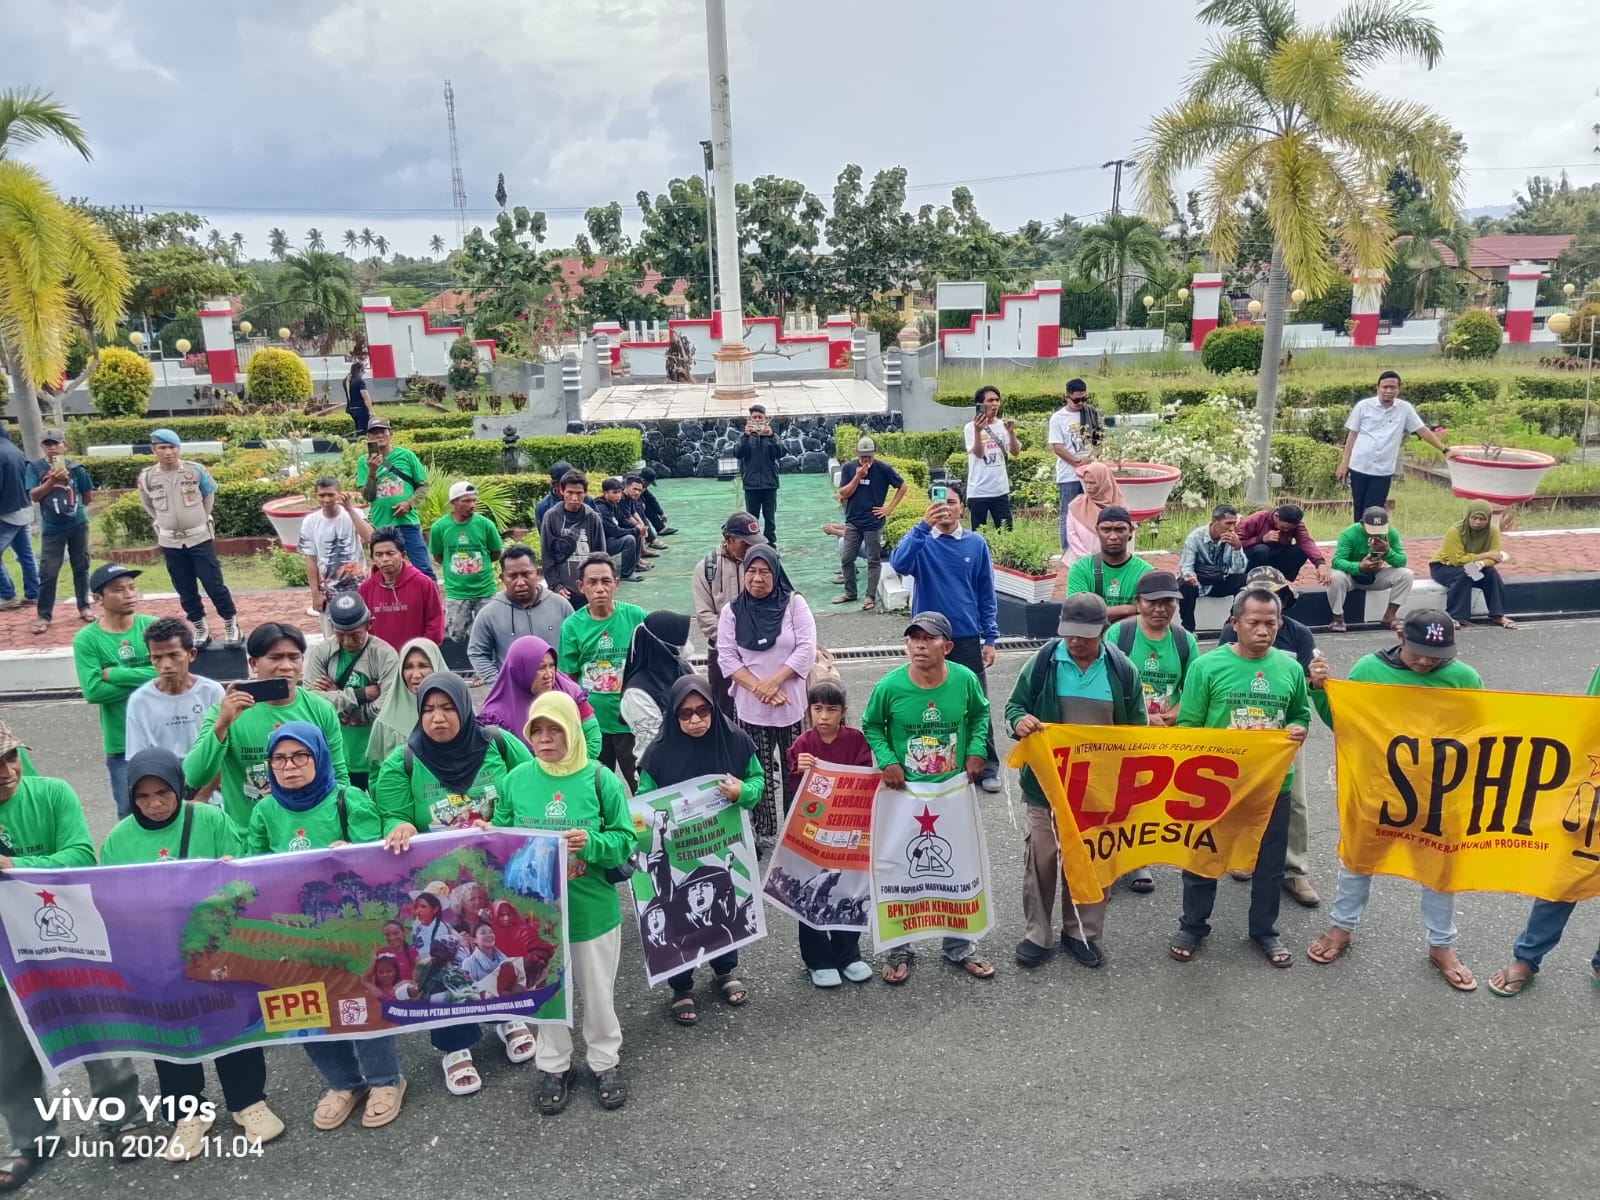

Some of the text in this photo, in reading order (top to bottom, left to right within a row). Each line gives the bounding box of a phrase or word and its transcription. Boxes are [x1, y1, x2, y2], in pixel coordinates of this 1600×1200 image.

[1074, 743, 1127, 755] INTERNATIONAL
[1128, 743, 1158, 752] LEAGUE
[1158, 743, 1170, 752] OF
[1207, 746, 1248, 756] STRUGGLE
[837, 777, 855, 790] BPN
[1379, 734, 1572, 836] SPHP
[674, 826, 690, 838] BPN
[692, 816, 718, 832] TOUNA
[675, 826, 726, 848] KEMBALIKAN
[677, 832, 743, 862] SERTIFIKAT KAMI
[1375, 828, 1550, 854] SERIKAT PEKERJA HUKUM PROGRESIF
[881, 885, 900, 894] FORUM
[901, 884, 924, 894] ASPIRASI
[925, 883, 958, 893] MASYARAKAT
[960, 884, 972, 894] TANI
[888, 898, 980, 918] BPN TOUNA KEMBALIKAN
[903, 915, 968, 930] SERTIFIKAT KAMI
[199, 991, 236, 1014] TANAH
[264, 989, 322, 1020] FPR
[388, 1006, 408, 1017] DUNIA
[409, 1007, 428, 1017] TANPA
[430, 1006, 450, 1016] PETANI
